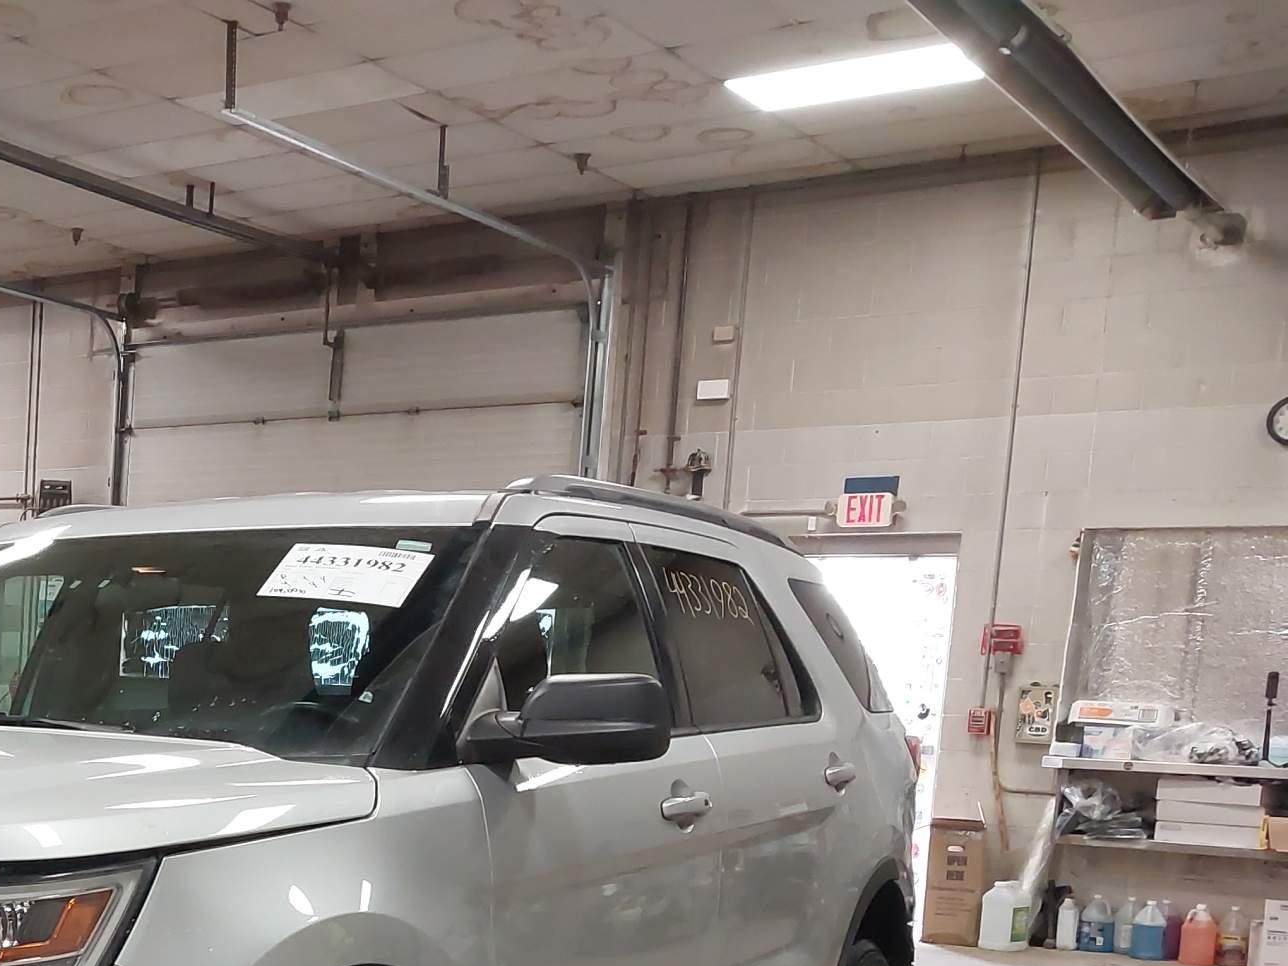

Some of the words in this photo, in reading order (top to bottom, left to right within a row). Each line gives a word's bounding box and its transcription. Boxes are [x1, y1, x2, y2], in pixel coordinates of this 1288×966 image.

[846, 495, 885, 523] EXIT
[296, 554, 407, 573] 44331982
[663, 567, 754, 625] 44331982
